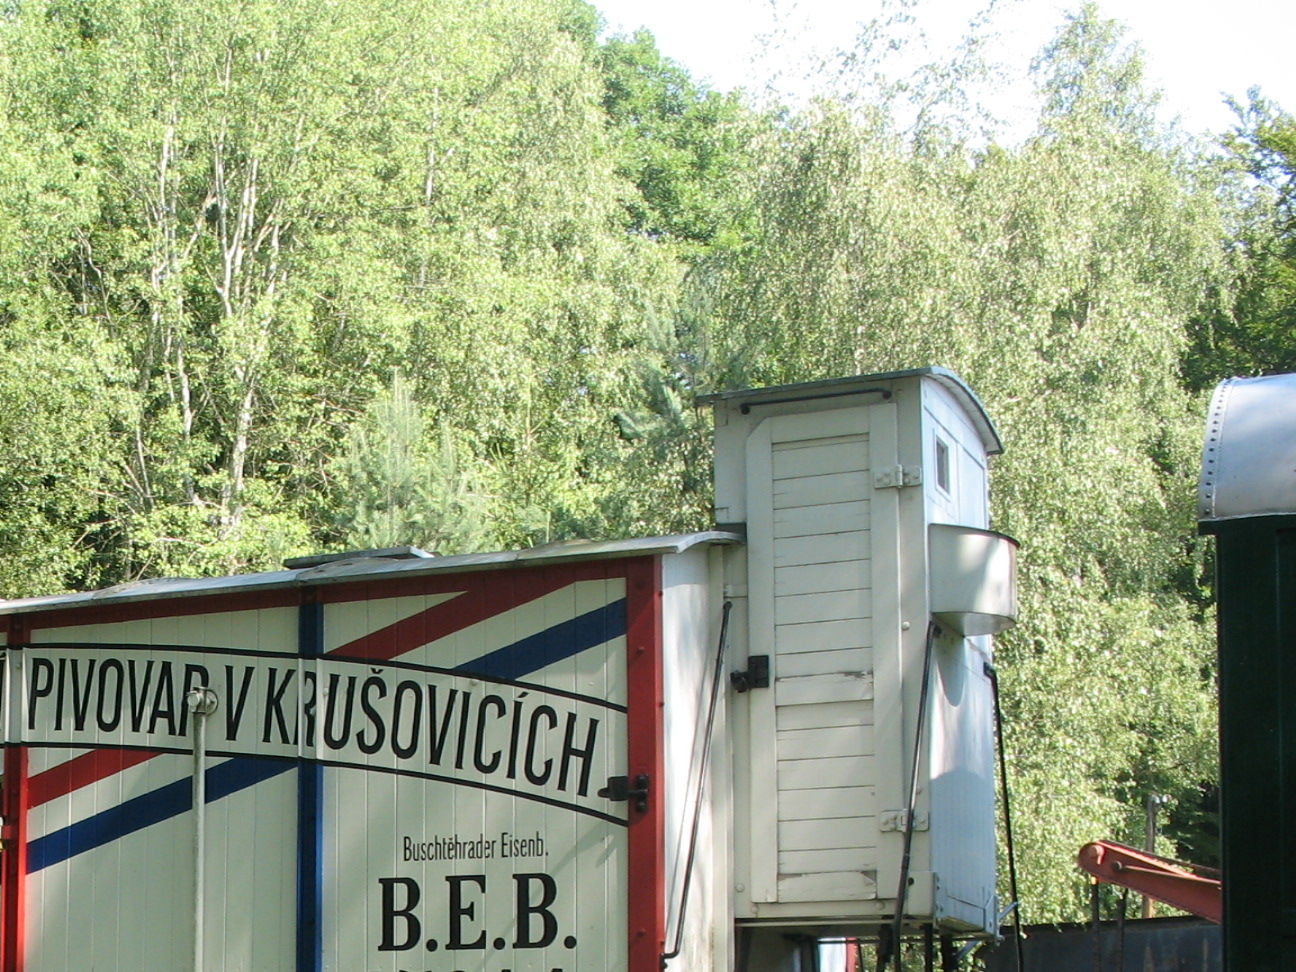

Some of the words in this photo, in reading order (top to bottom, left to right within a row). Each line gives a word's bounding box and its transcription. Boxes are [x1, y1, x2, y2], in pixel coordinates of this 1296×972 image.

[224, 665, 255, 741] V
[262, 667, 600, 797] KRUŠOVICÍCH
[501, 831, 549, 858] Eisenb.
[378, 873, 577, 952] B.E.B.
